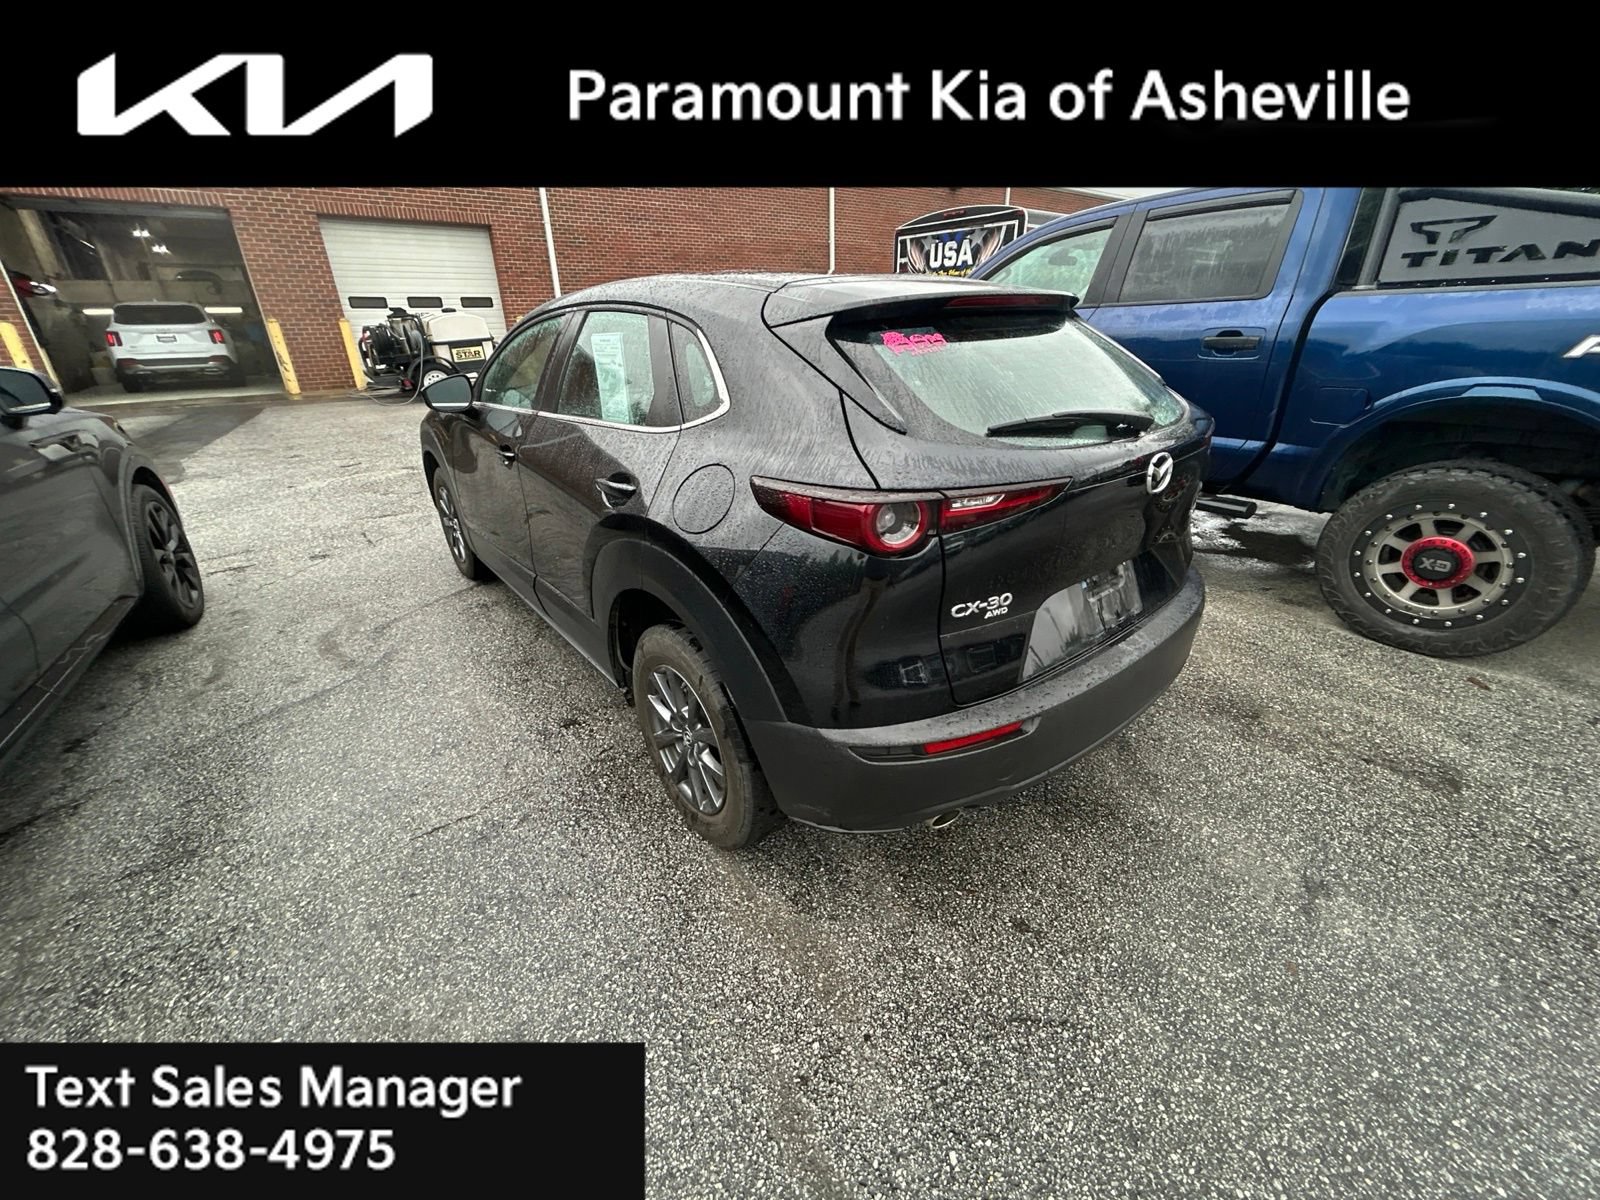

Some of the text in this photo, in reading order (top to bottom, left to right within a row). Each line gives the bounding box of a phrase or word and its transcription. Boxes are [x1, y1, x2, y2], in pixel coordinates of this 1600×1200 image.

[929, 239, 973, 269] USA
[1401, 239, 1600, 268] TITAN
[455, 350, 481, 359] STAR
[951, 592, 1013, 618] CX-30
[984, 606, 1008, 619] AWD
